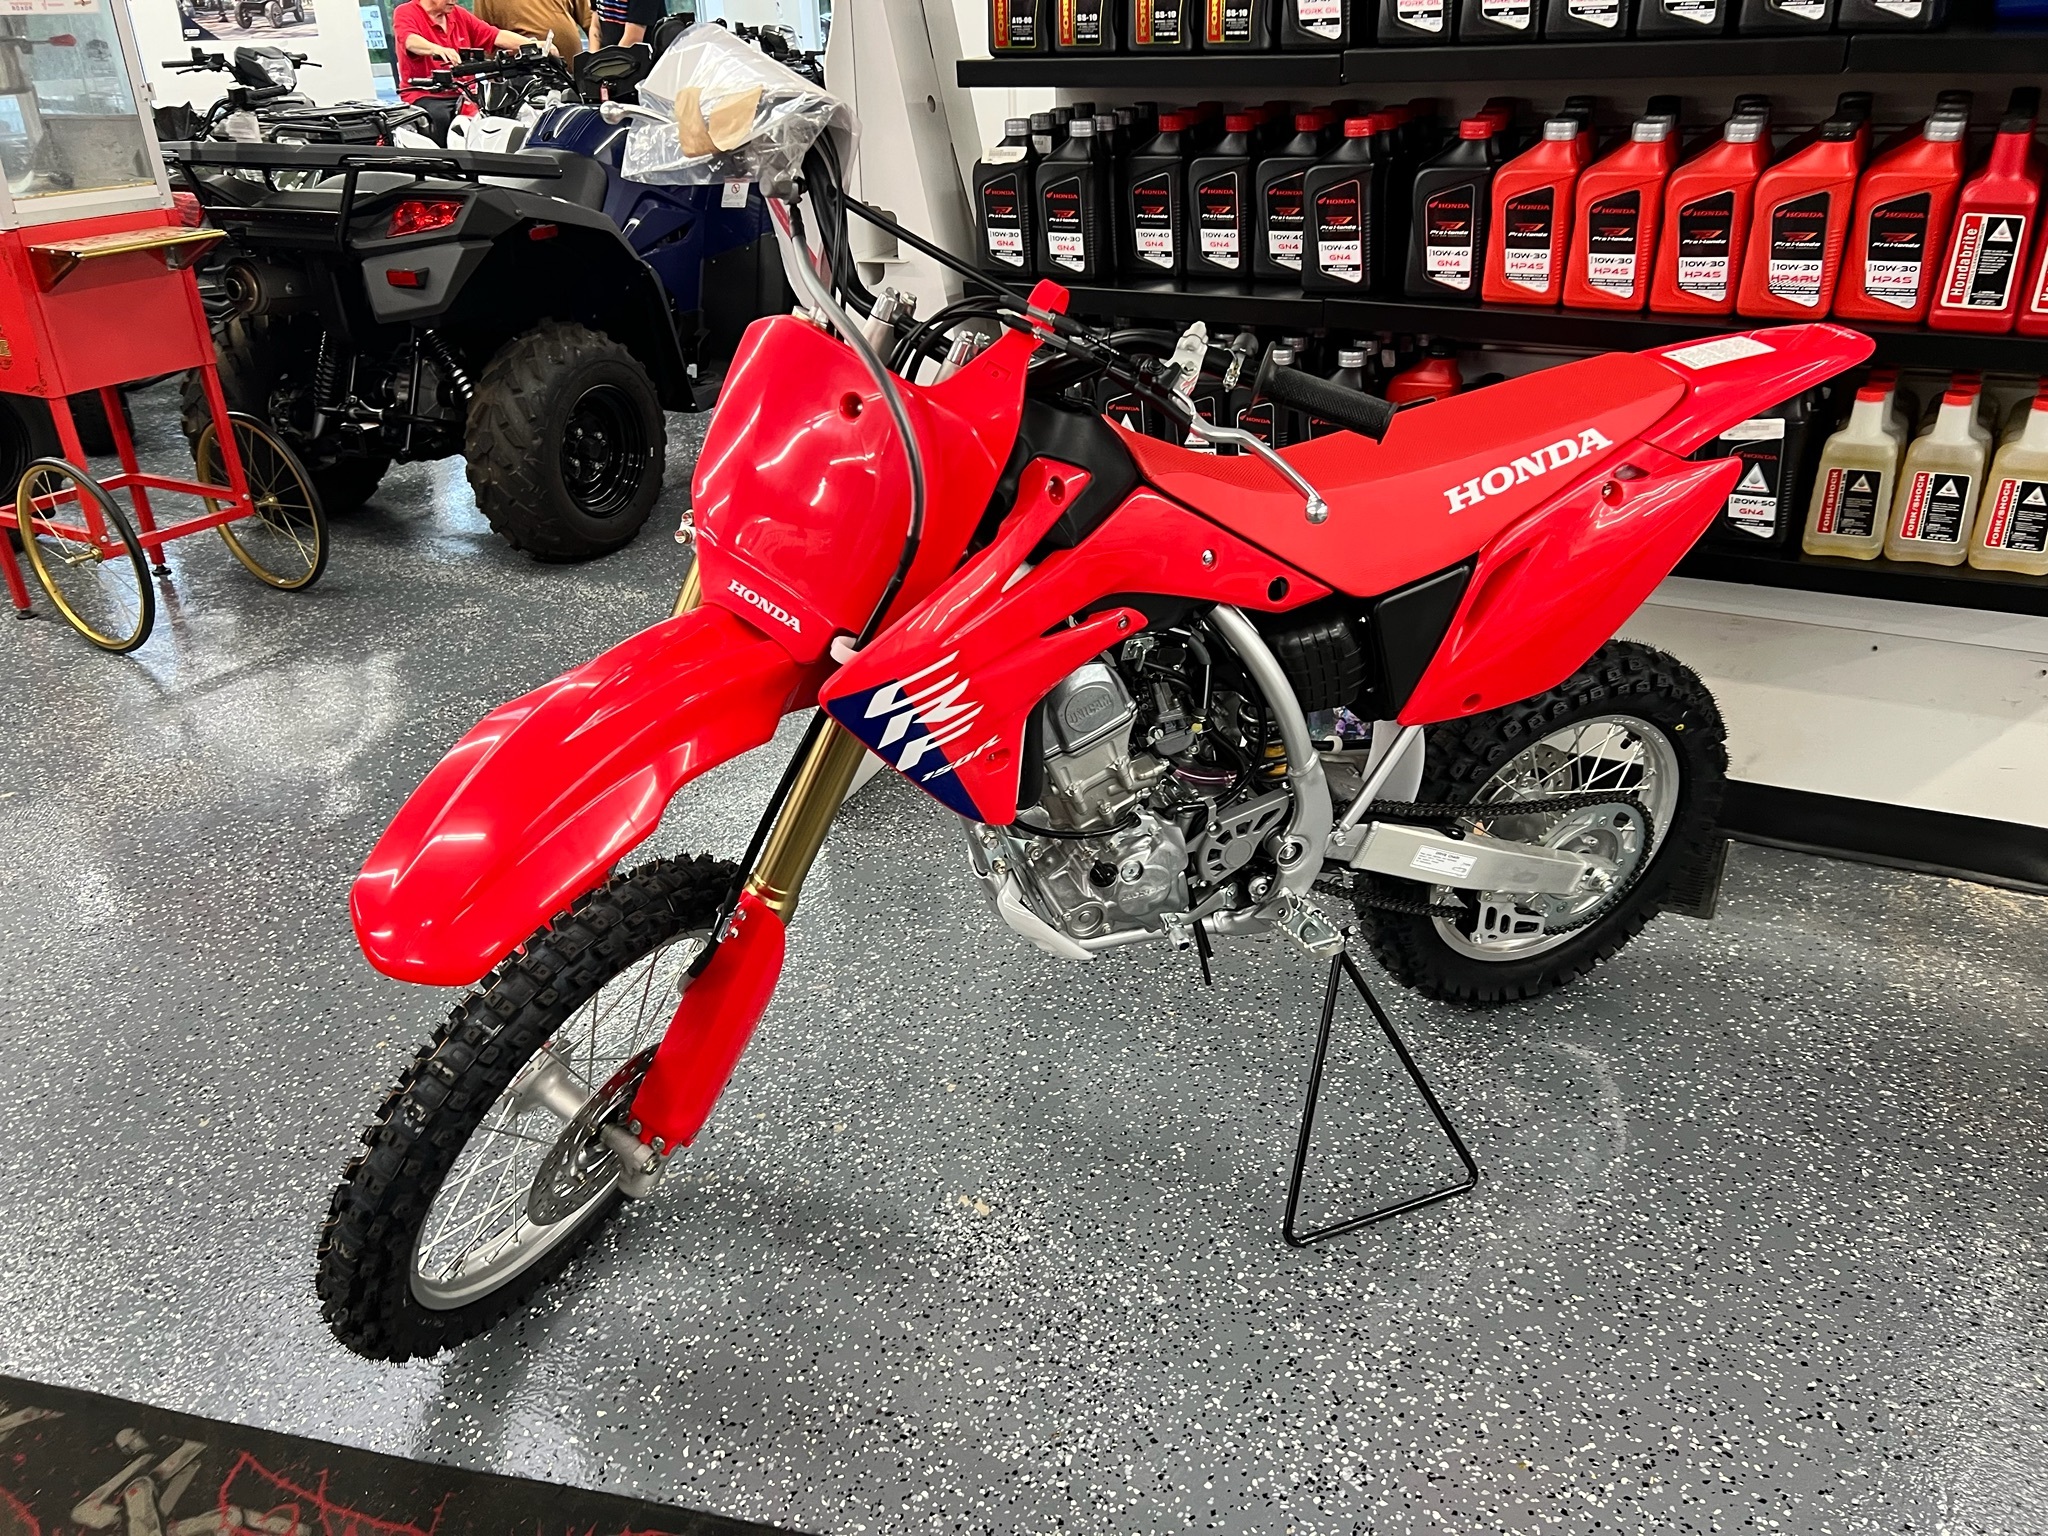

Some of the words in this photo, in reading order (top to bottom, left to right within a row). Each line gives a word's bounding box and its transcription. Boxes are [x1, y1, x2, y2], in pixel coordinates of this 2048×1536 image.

[1057, 244, 1075, 252] GN4
[1873, 264, 1917, 272] 10W-30
[1950, 228, 1978, 296] Hondabrite
[1872, 276, 1912, 284] HP4S
[1444, 428, 1613, 514] HONDA
[1734, 498, 1775, 506] 20W-50
[1738, 508, 1764, 516] GN4
[1822, 472, 1839, 532] FORK/SHOCK
[1907, 475, 1926, 536] FORK/SHOCK
[1990, 482, 2012, 544] FORK/SHOCK
[727, 579, 801, 634] HONDA
[1070, 694, 1112, 724] UNICAM
